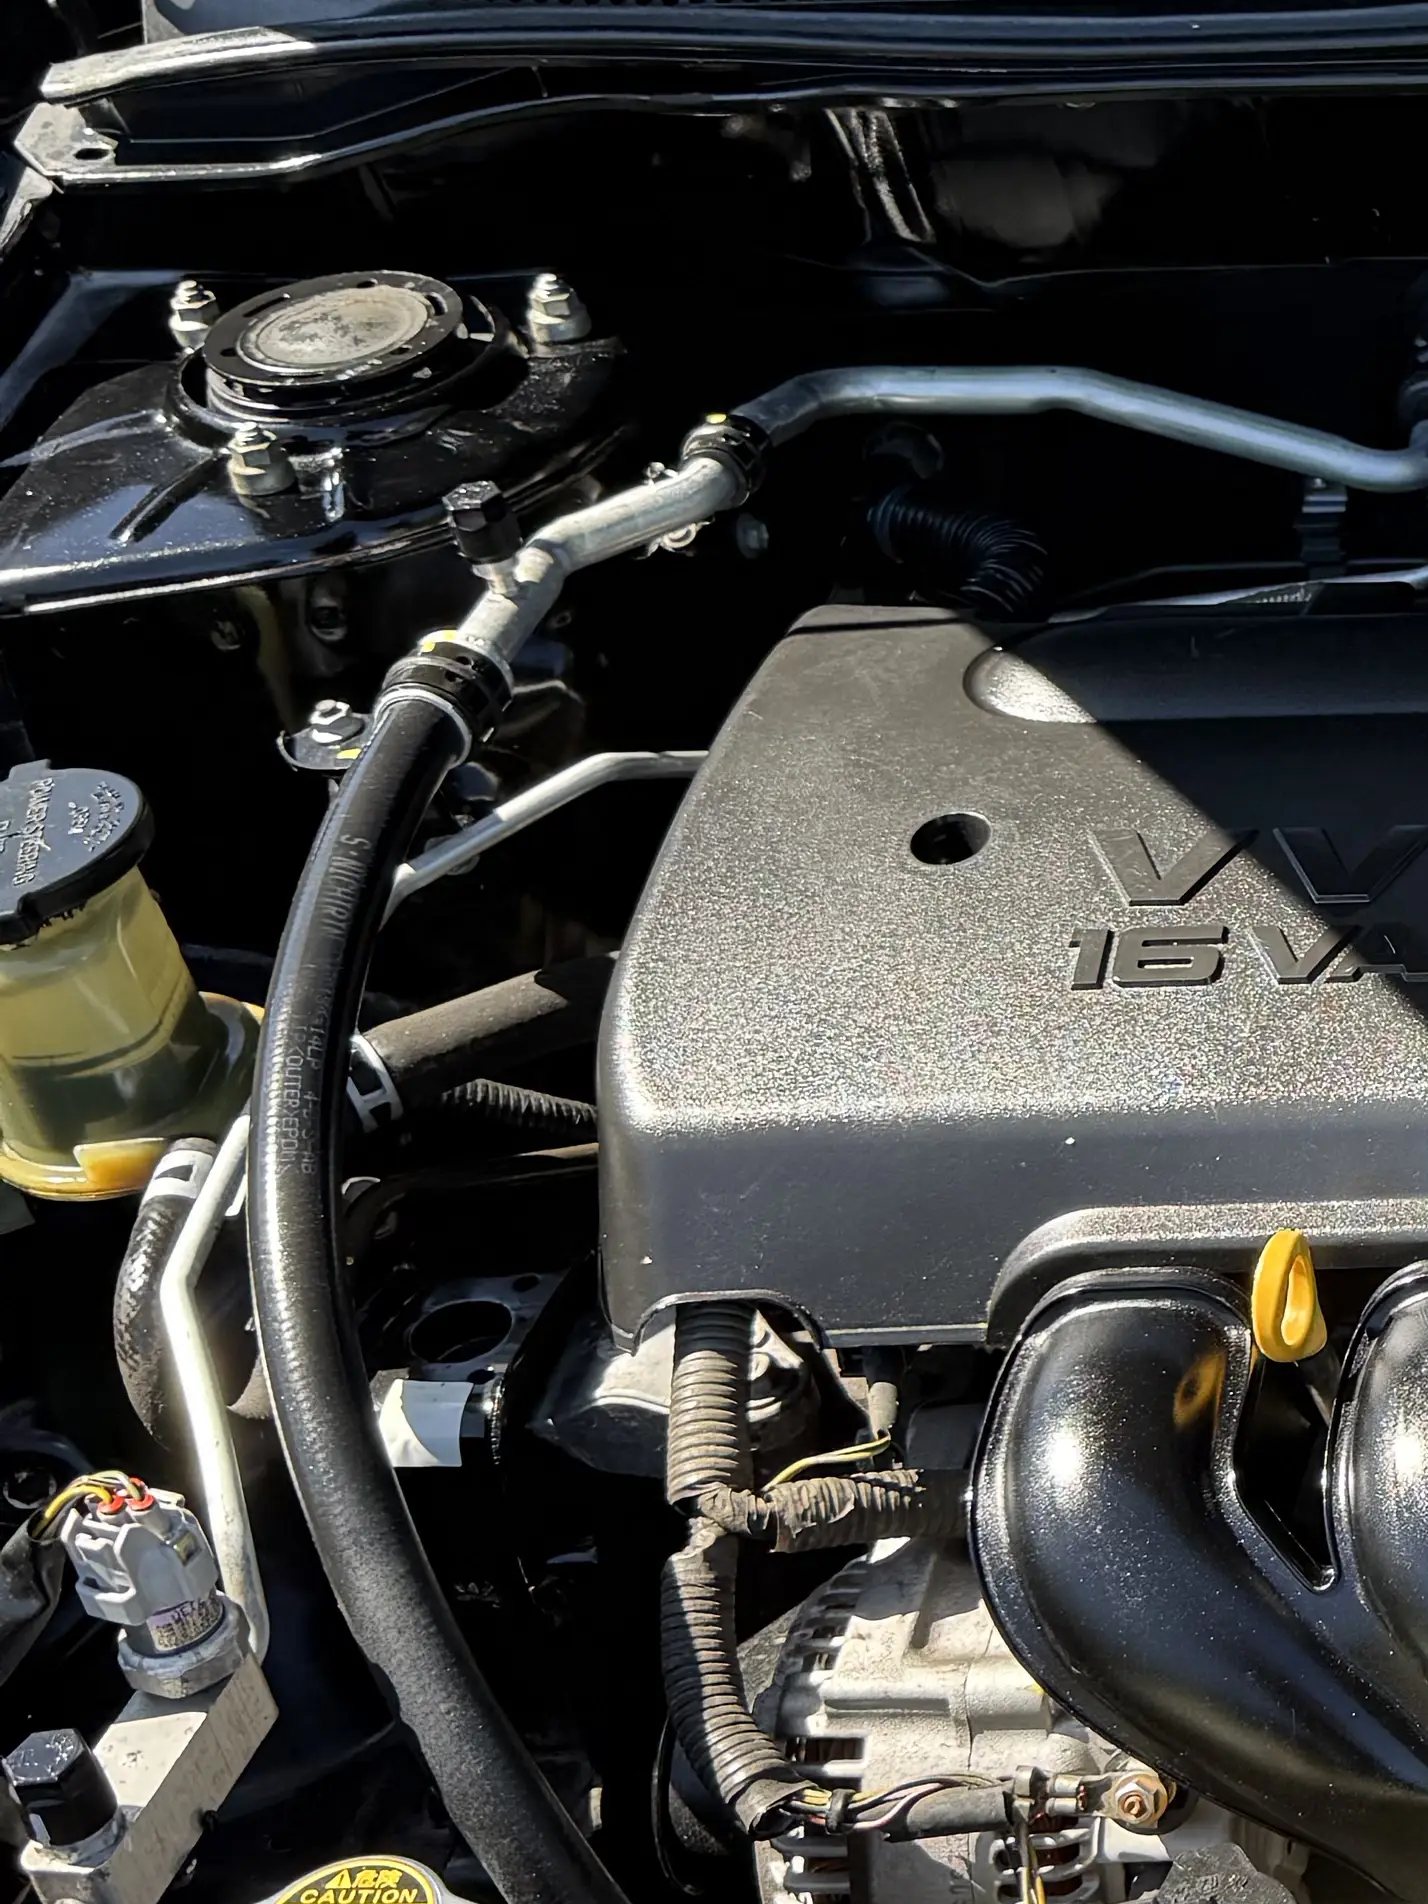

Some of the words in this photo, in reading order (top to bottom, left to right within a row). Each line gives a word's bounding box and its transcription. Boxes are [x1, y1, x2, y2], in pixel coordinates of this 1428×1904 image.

[24, 777, 55, 827] POWER
[1068, 922, 1229, 991] 16
[300, 1888, 418, 1904] CAUTION
